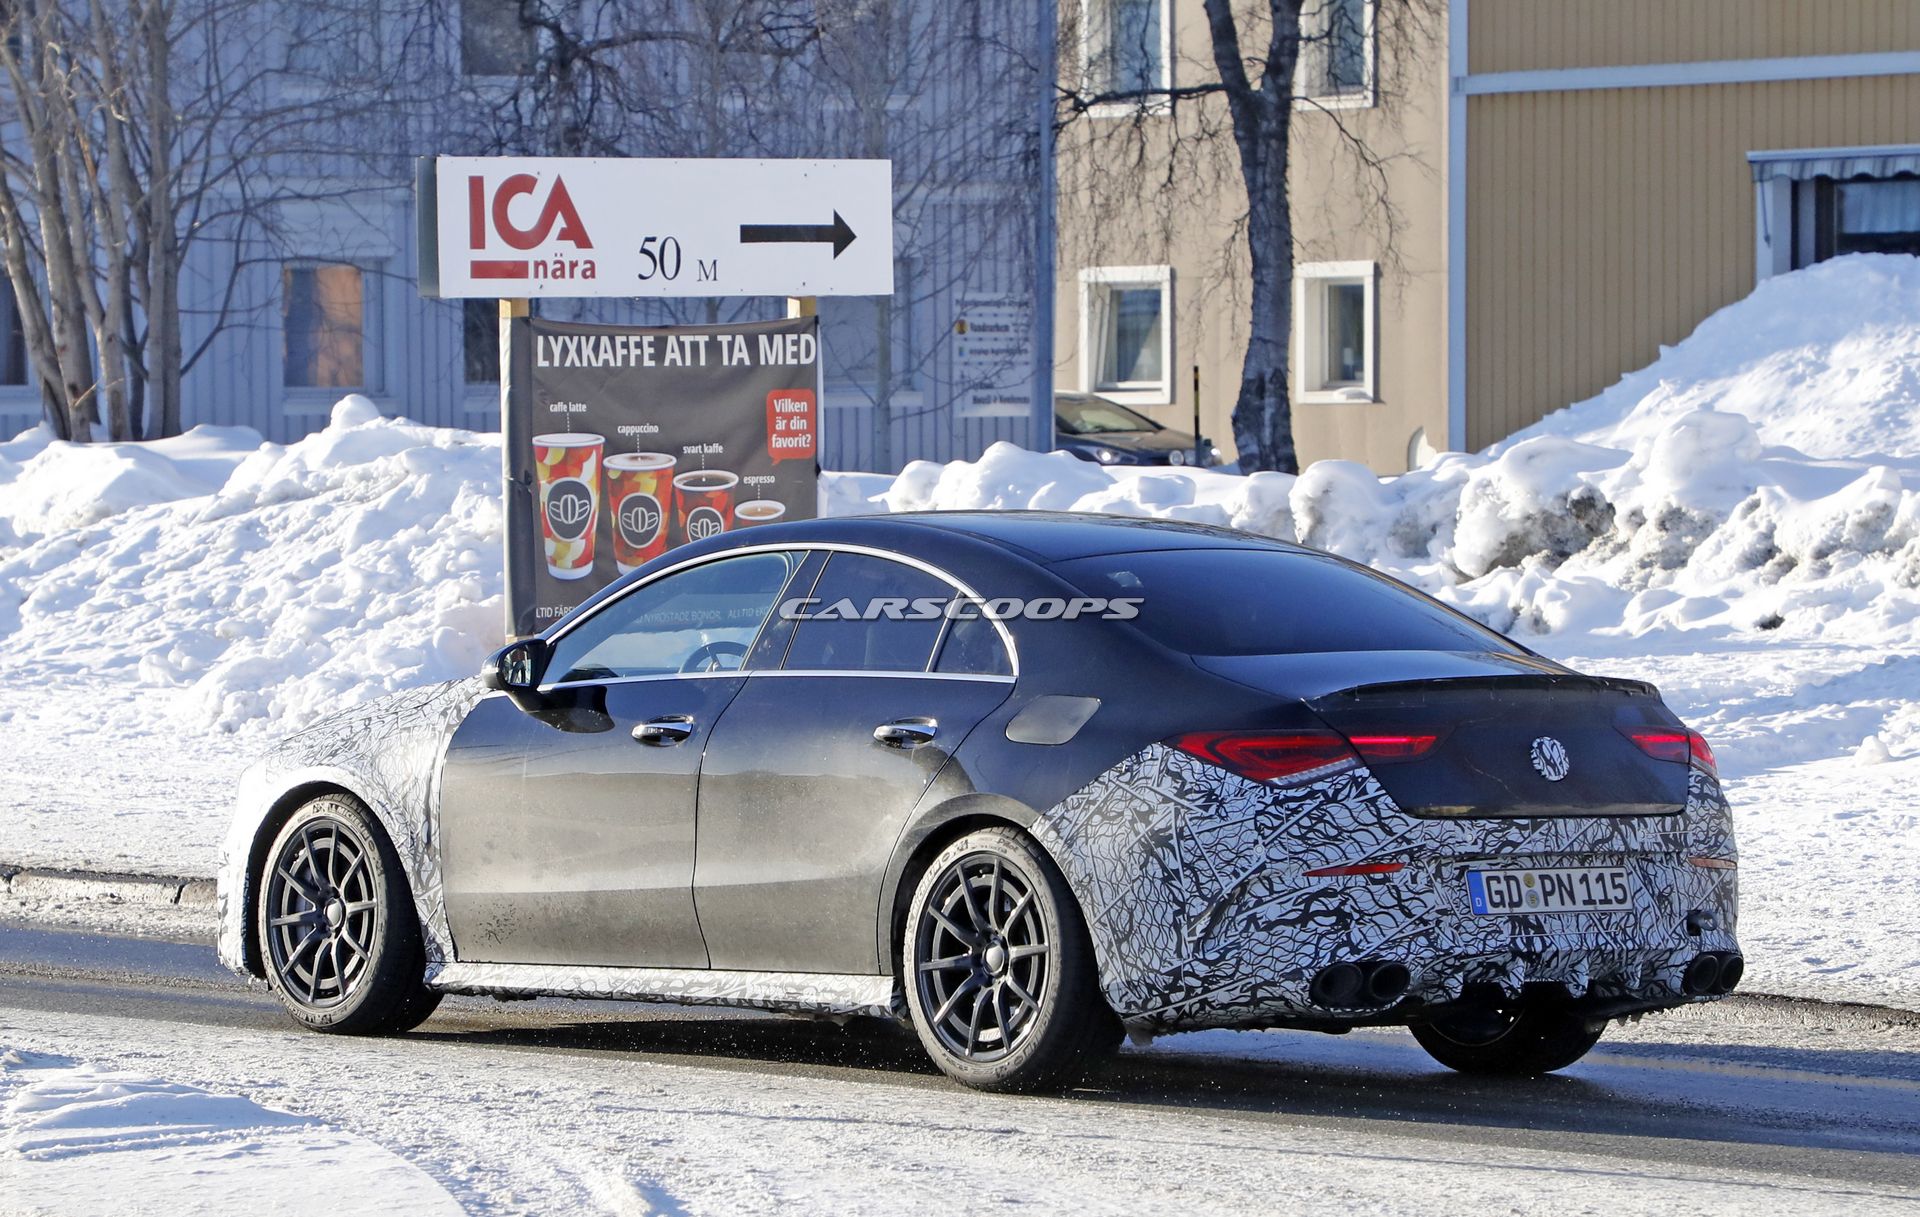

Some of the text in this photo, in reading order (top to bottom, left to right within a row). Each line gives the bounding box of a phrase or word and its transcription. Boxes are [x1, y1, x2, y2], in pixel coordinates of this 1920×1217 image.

[468, 173, 593, 250] ICA
[533, 252, 596, 280] nära
[638, 237, 719, 282] 50 M
[536, 333, 816, 368] LYXKAFFE ATT TA MED
[549, 402, 587, 413] caffe latte
[773, 398, 808, 414] Vilken
[617, 422, 659, 437] cappuccino
[775, 416, 807, 431] är din
[682, 442, 724, 454] svart kaffe
[771, 433, 812, 449] favorit?
[743, 474, 776, 487] espresso
[535, 606, 553, 619] LTID
[1485, 872, 1628, 908] GD PN 115
